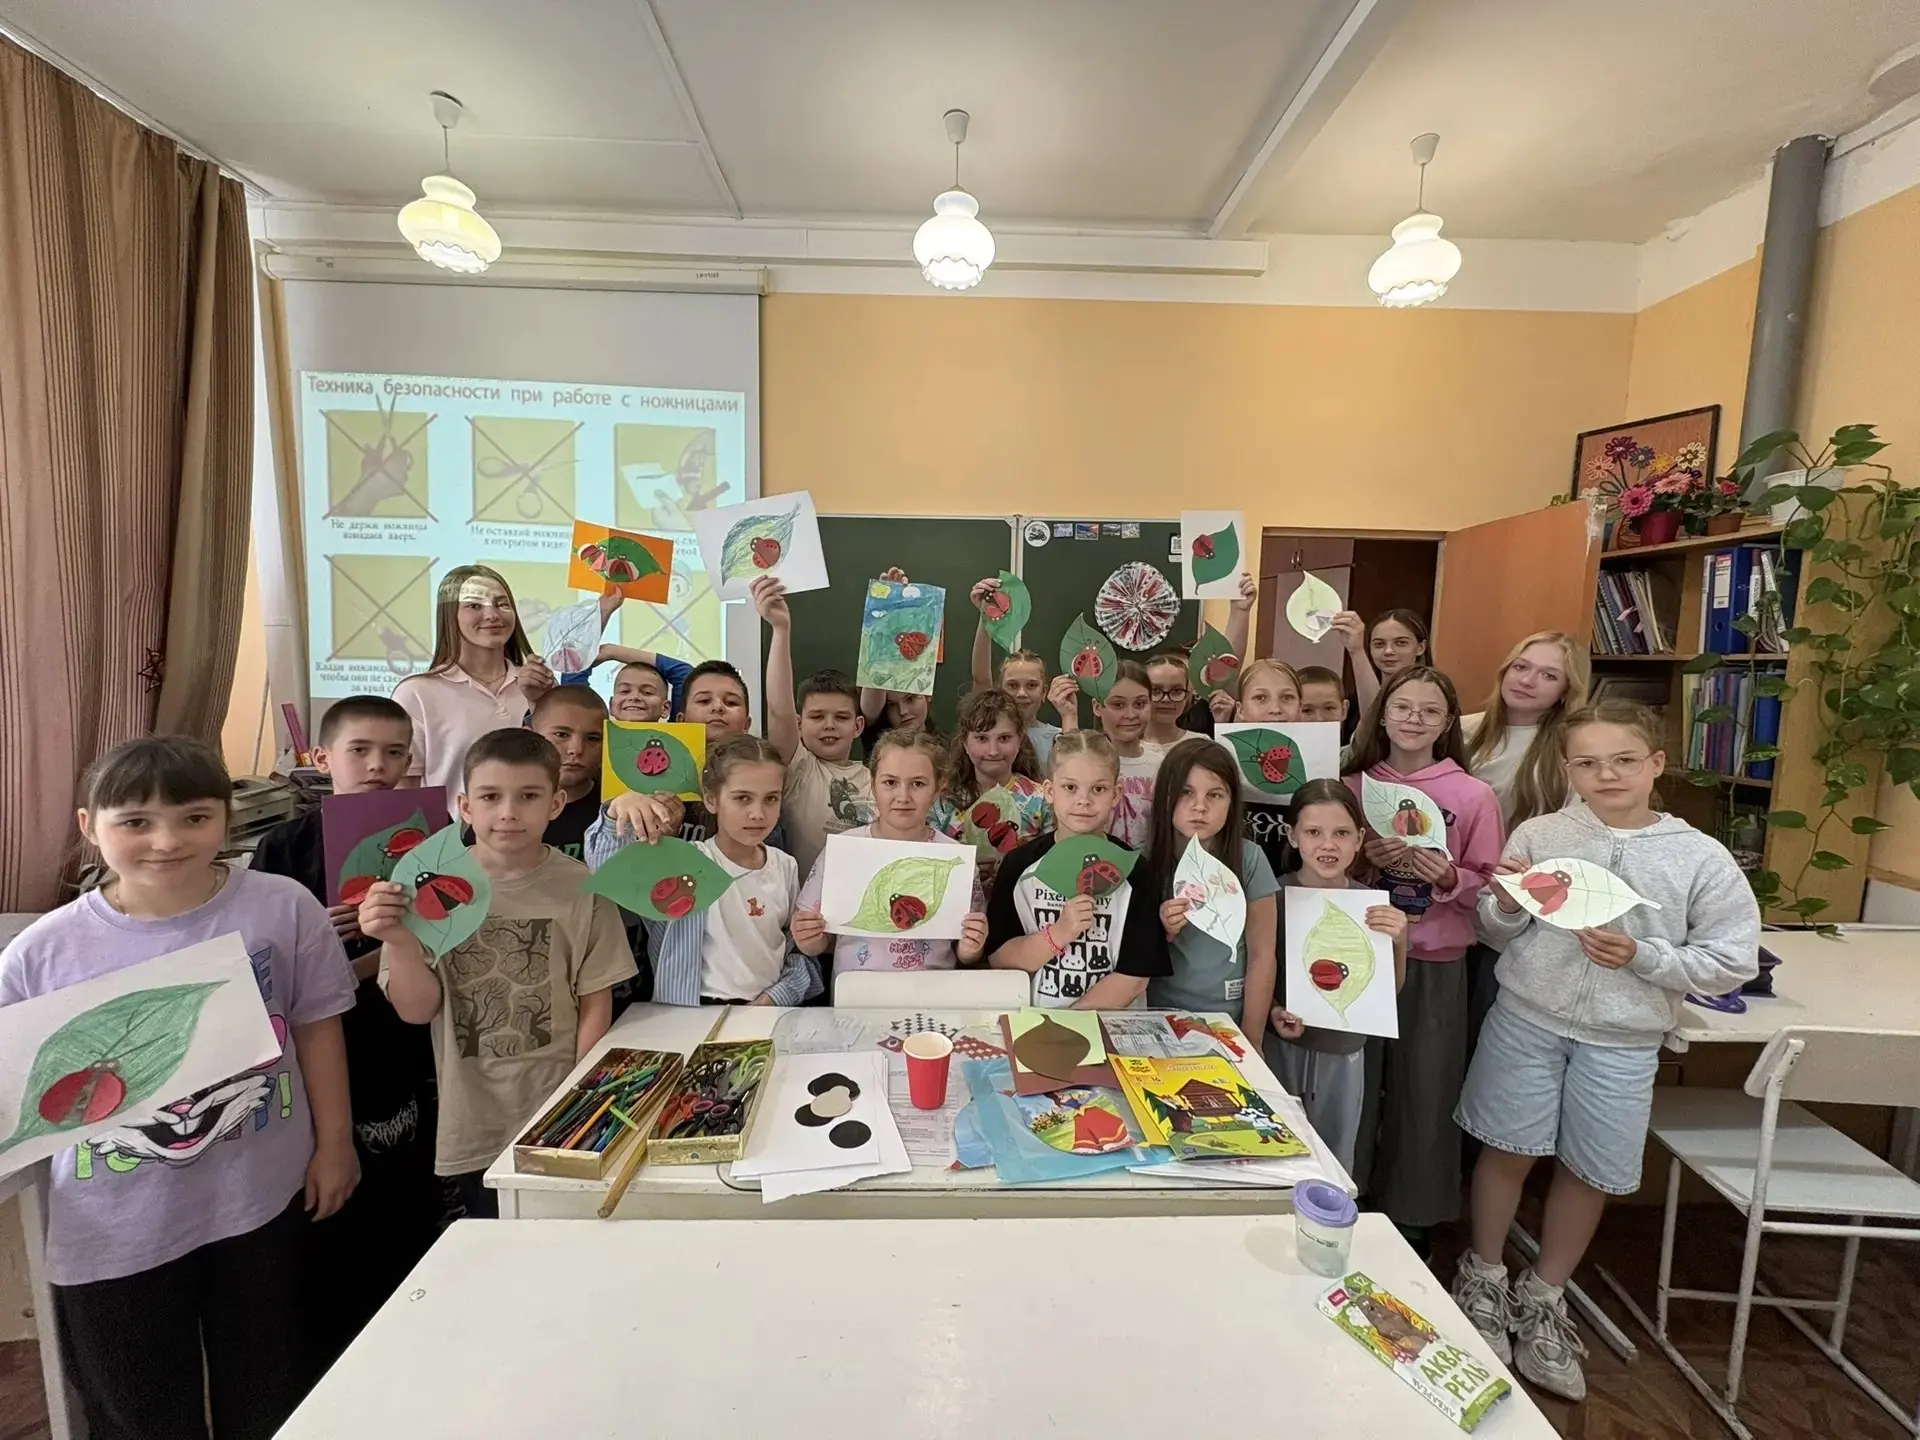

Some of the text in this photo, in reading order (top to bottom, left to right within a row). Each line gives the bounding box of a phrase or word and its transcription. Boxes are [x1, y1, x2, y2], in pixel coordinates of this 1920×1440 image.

[308, 375, 738, 414] Техника безопасности при работе с ножницами
[1420, 1344, 1468, 1386] АКВА
[1443, 1363, 1491, 1402] РЕЛЬ
[1412, 1378, 1456, 1418] АКВАРЕЛЬ
